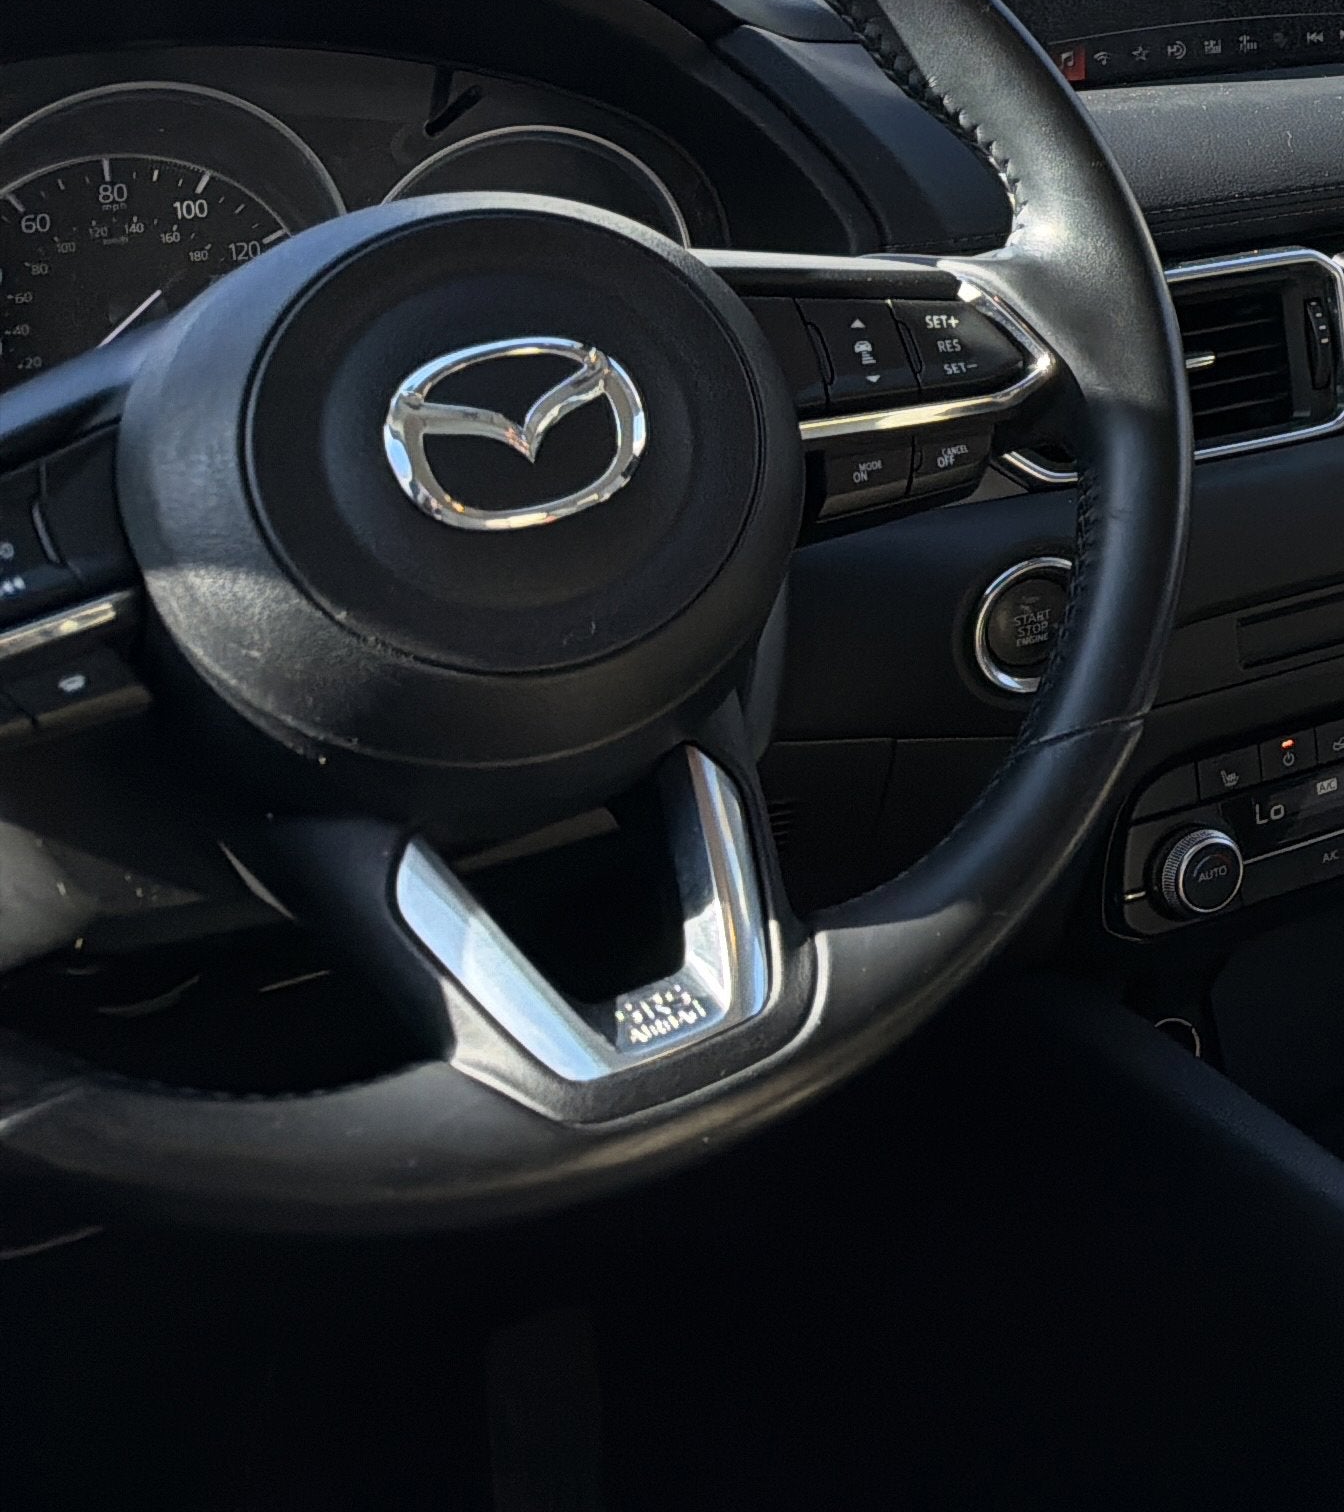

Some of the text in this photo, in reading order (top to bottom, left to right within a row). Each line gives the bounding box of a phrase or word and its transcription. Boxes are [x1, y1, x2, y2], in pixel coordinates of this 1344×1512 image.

[98, 183, 128, 205] 80
[173, 199, 208, 220] 100
[20, 213, 51, 234] 60
[124, 222, 144, 235] 140
[89, 226, 108, 238] 120
[160, 232, 181, 244] 160
[57, 241, 77, 254] 100
[228, 240, 262, 262] 120
[188, 250, 209, 263] 180
[31, 263, 49, 276] 80
[15, 291, 33, 303] 60
[925, 314, 960, 329] SET+
[12, 324, 30, 336] 40
[936, 339, 962, 353] RES
[24, 356, 42, 369] 20
[941, 444, 969, 457] CANCEL
[858, 459, 883, 472] MODE
[936, 455, 955, 469] OFF
[852, 471, 868, 484] ON
[1014, 608, 1051, 626] START
[1017, 621, 1049, 637] STOP
[1016, 633, 1049, 647] ENGINE
[1322, 849, 1340, 864] A/C
[1198, 864, 1228, 883] AUTO
